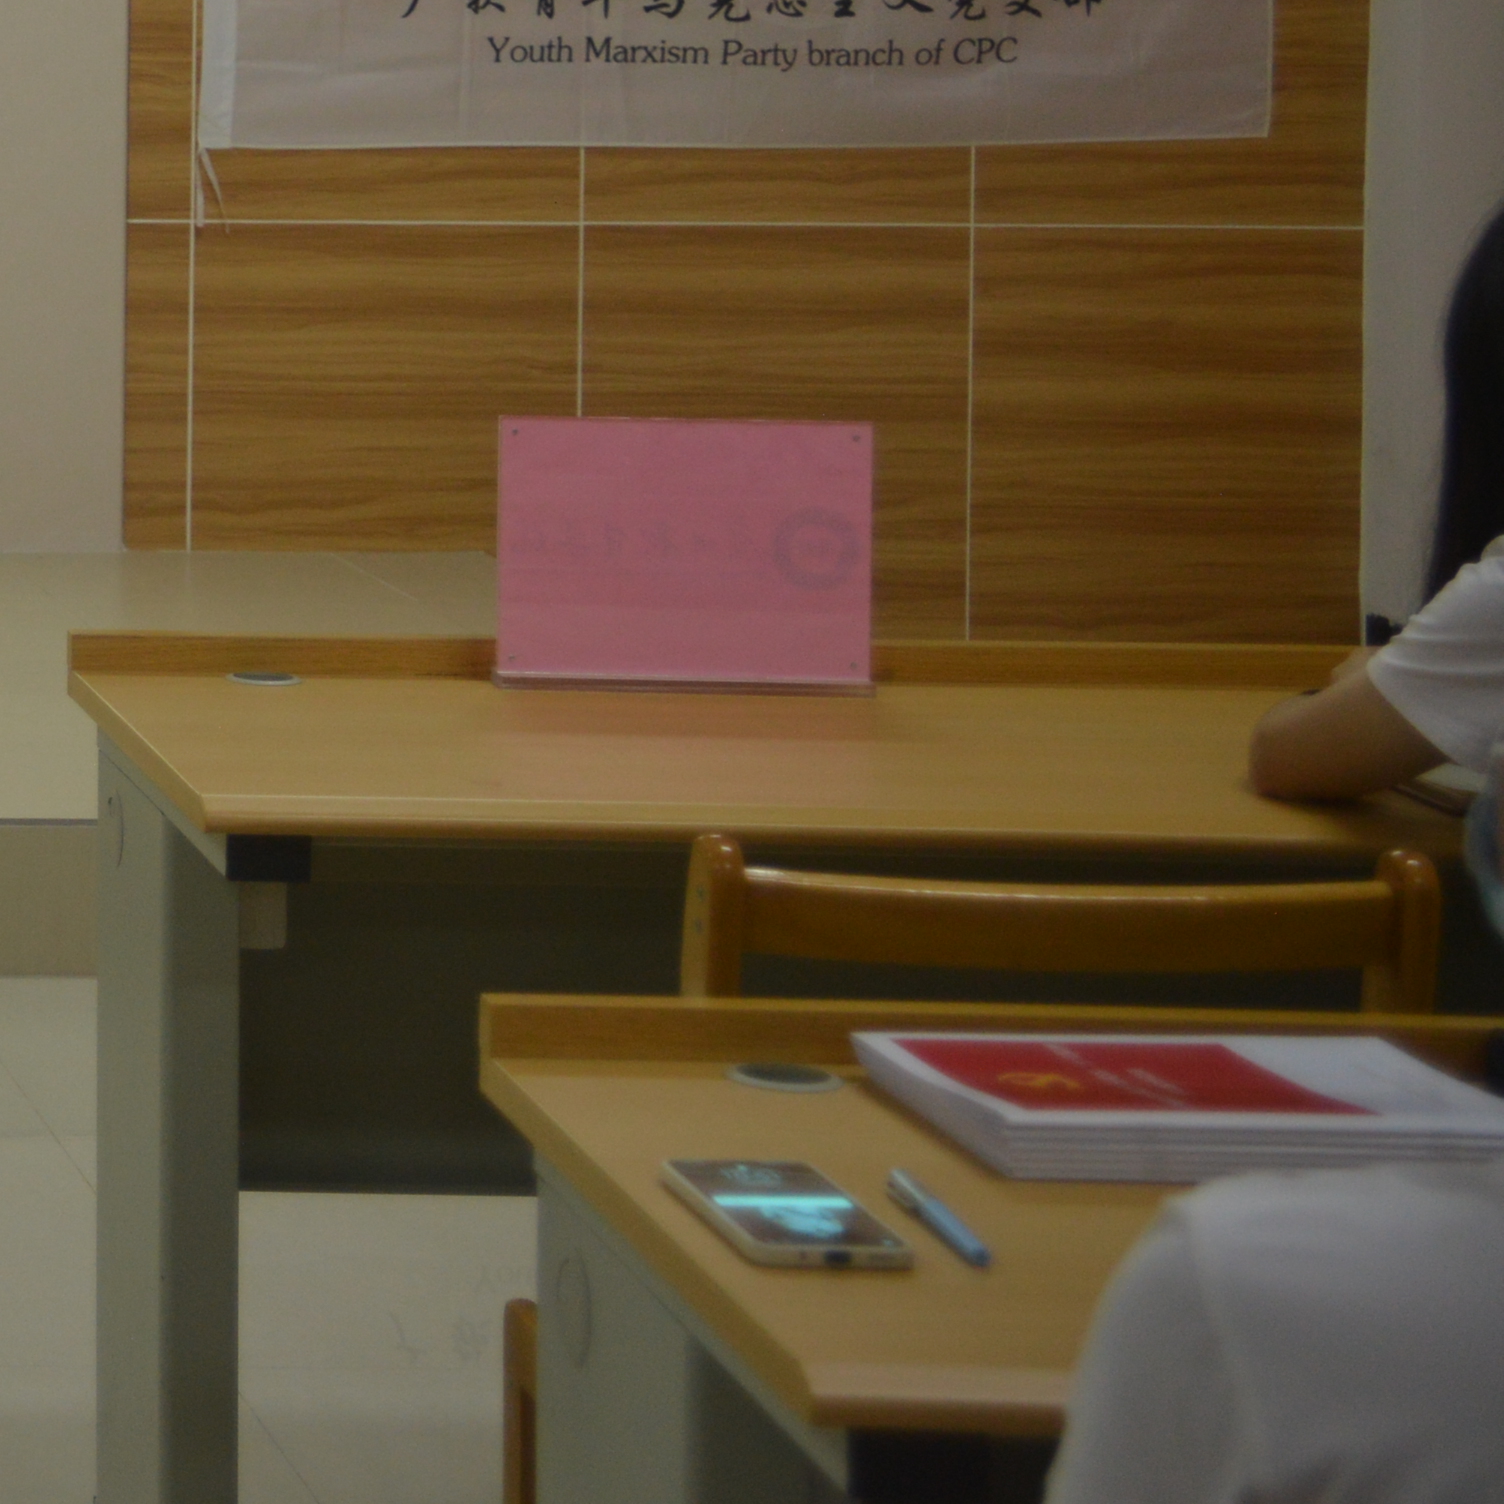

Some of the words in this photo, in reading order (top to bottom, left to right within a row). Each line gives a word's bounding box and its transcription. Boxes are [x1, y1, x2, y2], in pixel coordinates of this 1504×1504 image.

[487, 35, 575, 64] Youth
[584, 36, 710, 66] Marxism
[720, 39, 798, 73] Party
[806, 39, 905, 67] branch
[914, 38, 946, 66] of
[952, 36, 1019, 65] CPC
